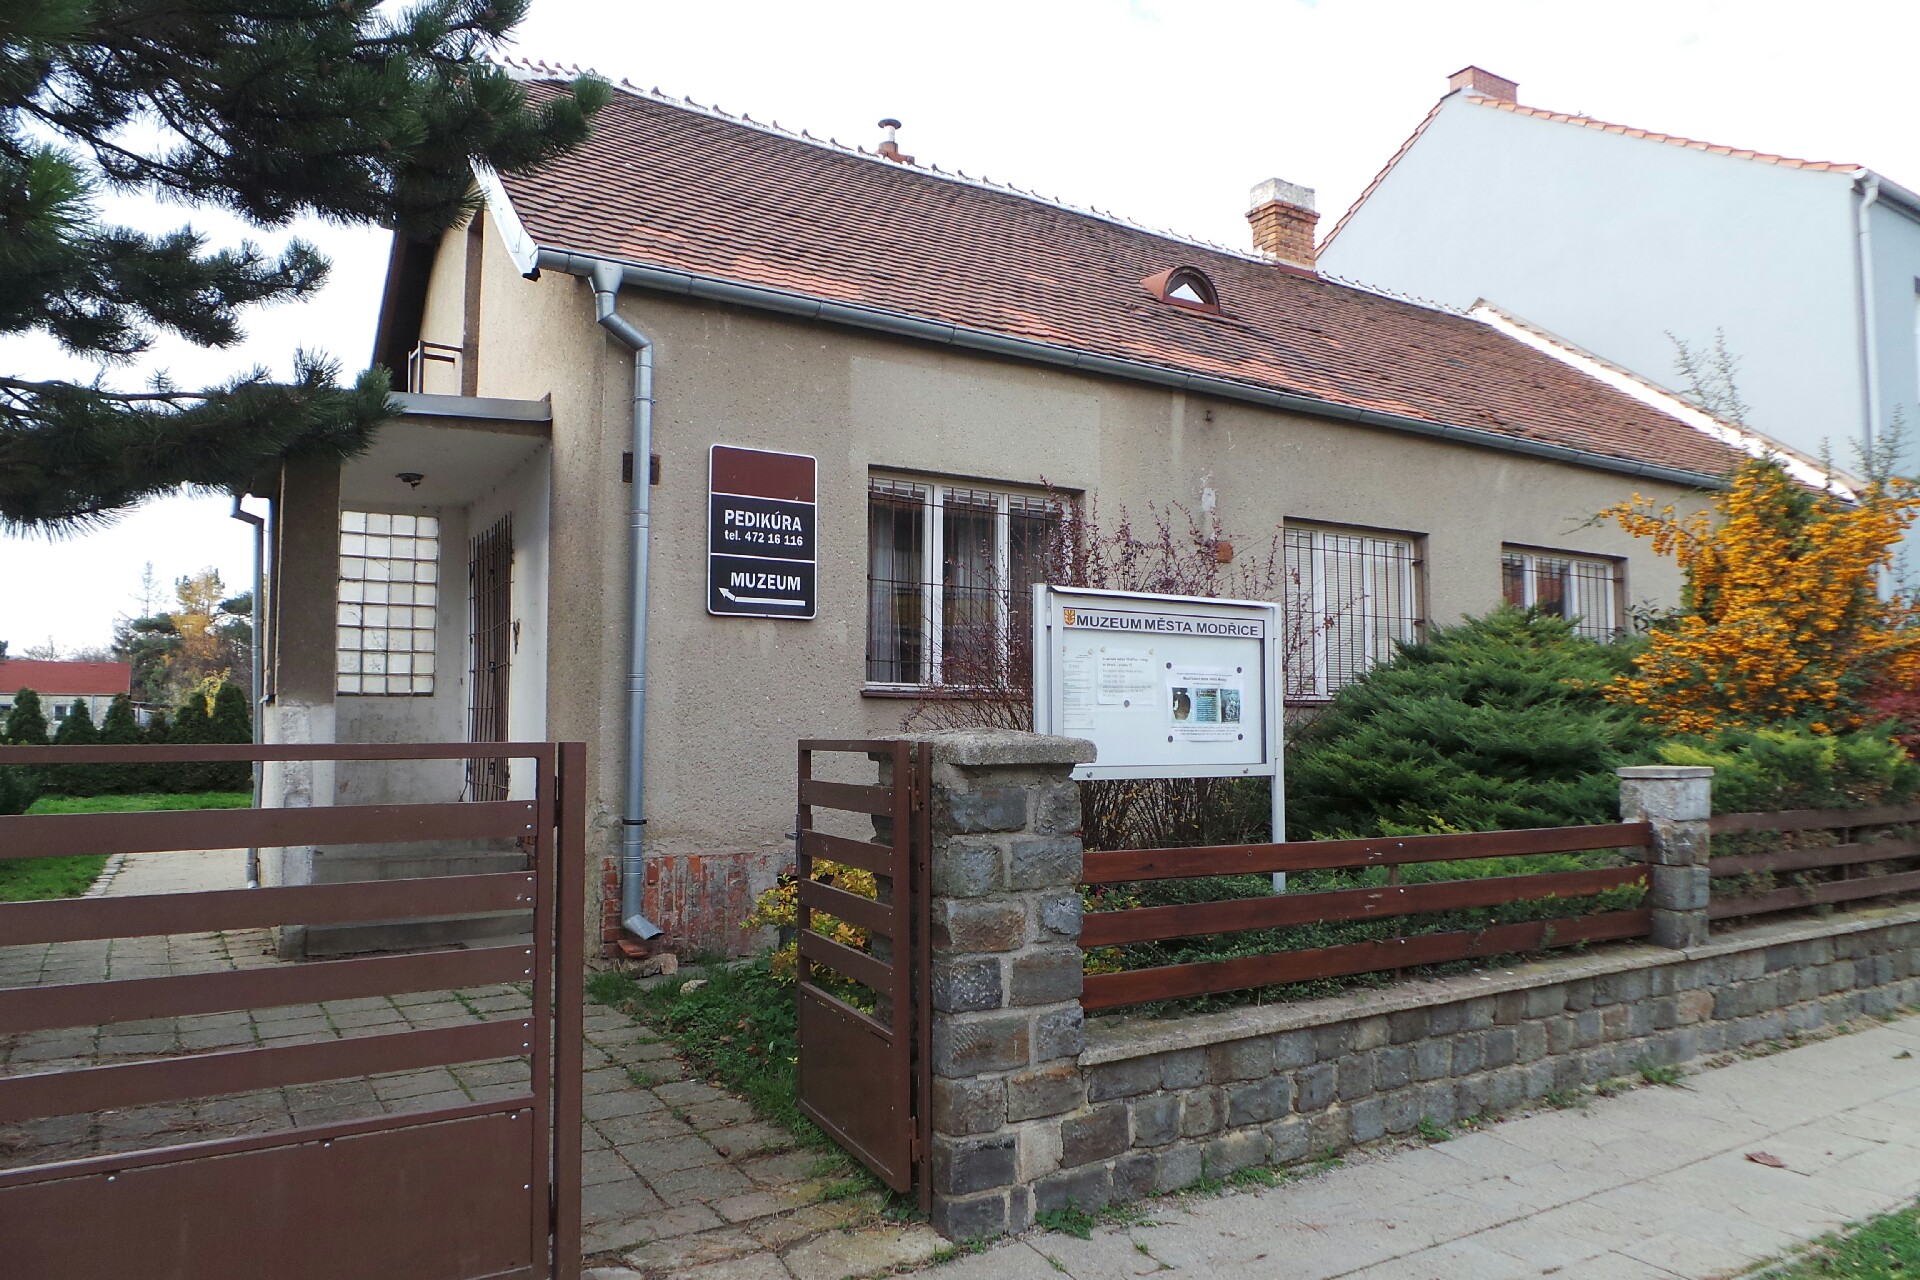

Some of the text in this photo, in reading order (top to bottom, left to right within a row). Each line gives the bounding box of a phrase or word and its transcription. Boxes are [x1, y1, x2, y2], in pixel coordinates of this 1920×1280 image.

[724, 509, 802, 531] PEDIKÚRA
[724, 530, 803, 546] tel. 472 16 116
[730, 572, 801, 591] MUZEUM
[1076, 614, 1259, 636] MUZEUM MĚSTA MODŘICE
